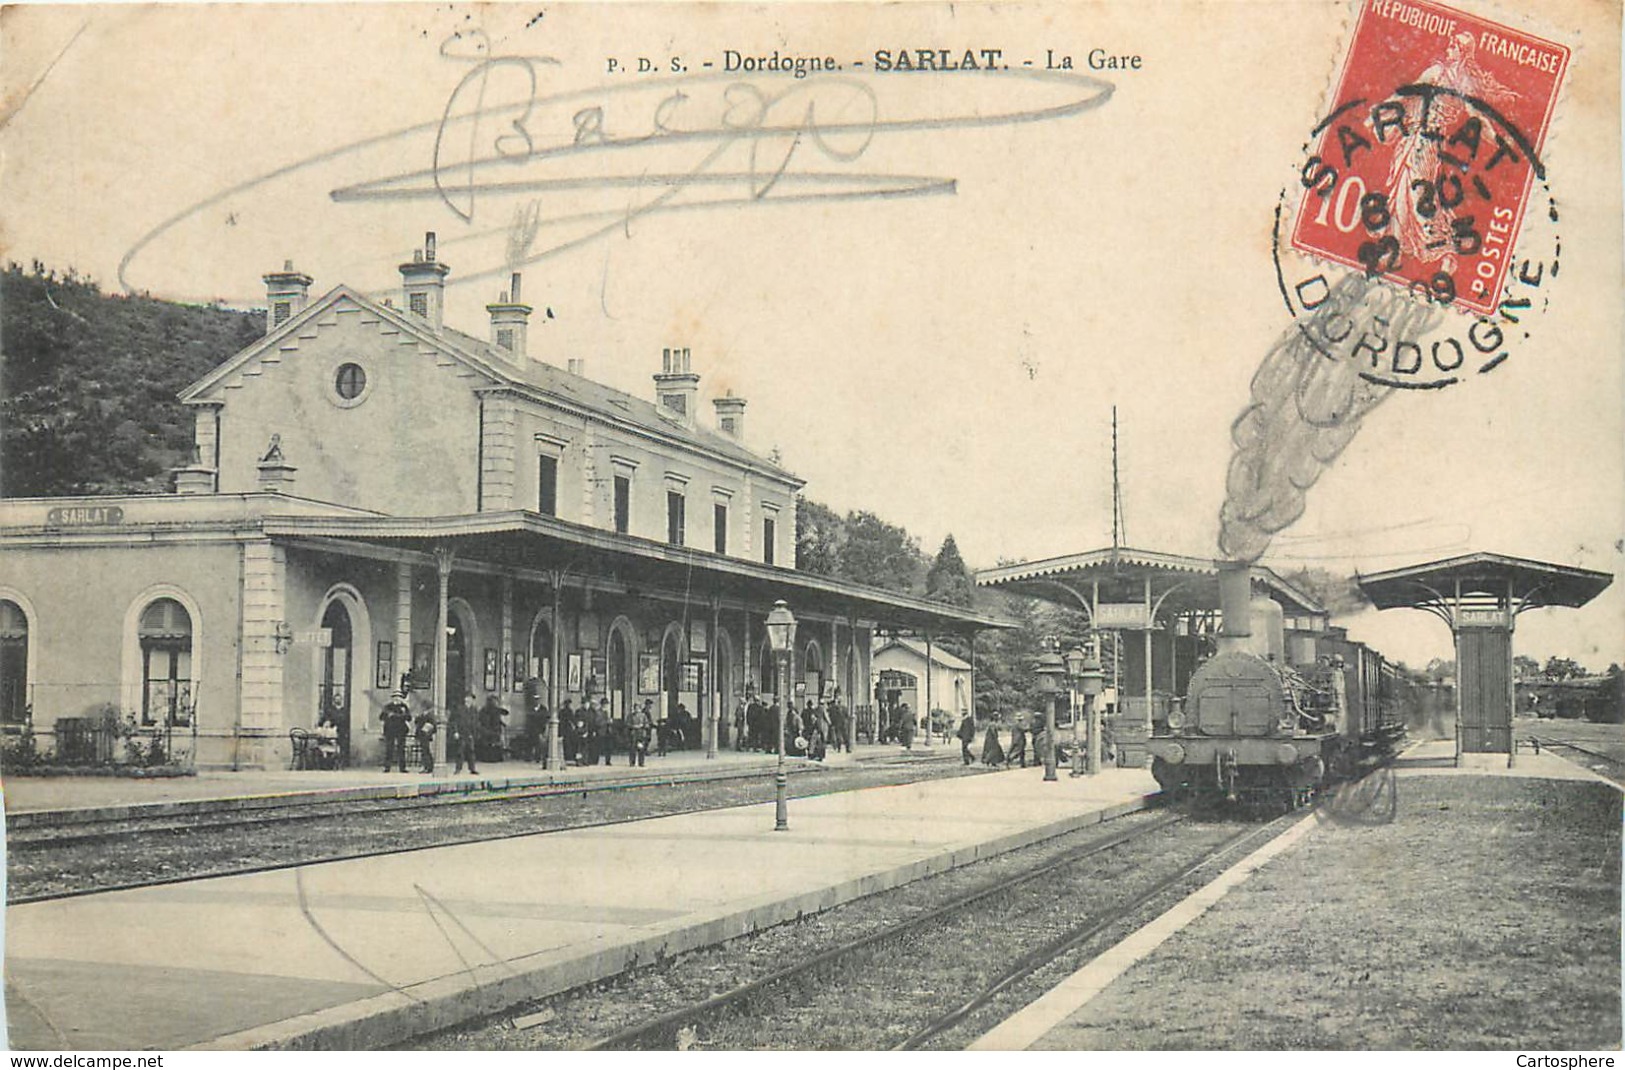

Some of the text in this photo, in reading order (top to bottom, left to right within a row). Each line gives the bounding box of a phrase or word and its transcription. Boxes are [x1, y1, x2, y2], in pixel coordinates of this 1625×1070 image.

[1478, 31, 1559, 74] FRANÇAISE
[1313, 176, 1366, 233] 10
[1471, 206, 1513, 297] POSTES
[61, 507, 109, 524] SARLAT
[1462, 610, 1505, 622] SARLAT
